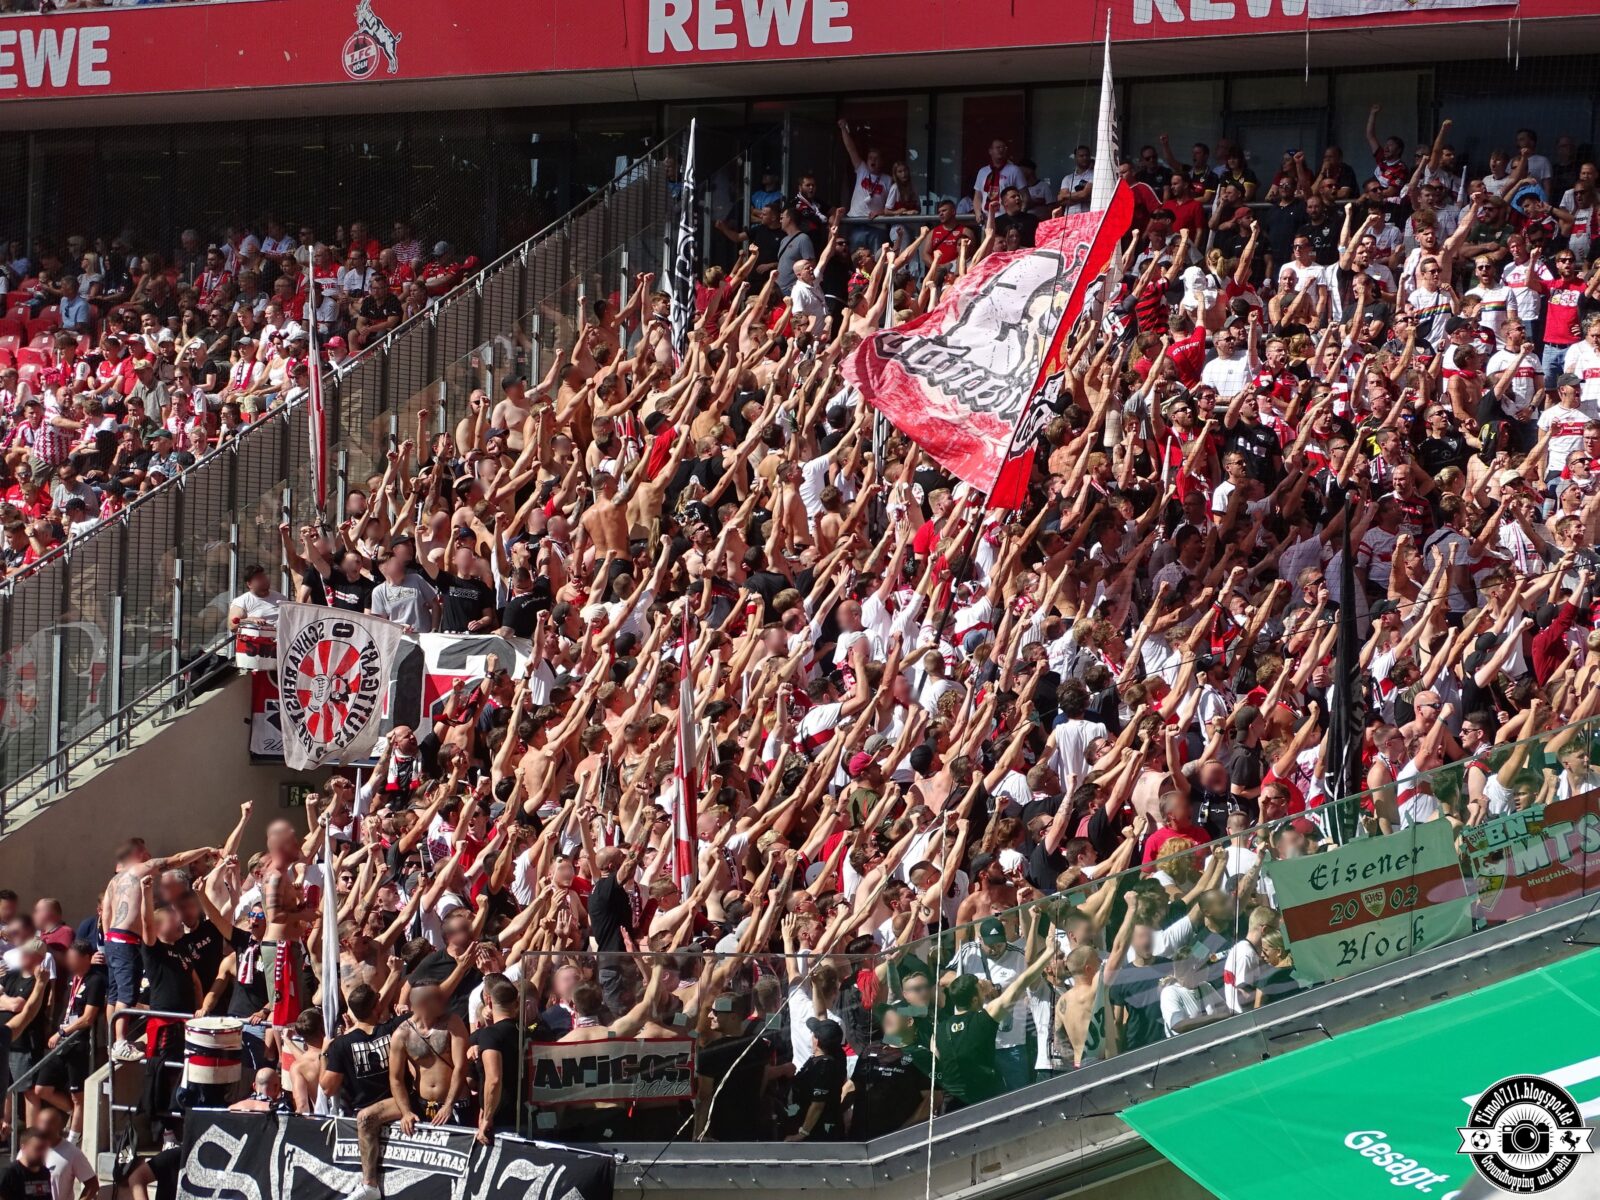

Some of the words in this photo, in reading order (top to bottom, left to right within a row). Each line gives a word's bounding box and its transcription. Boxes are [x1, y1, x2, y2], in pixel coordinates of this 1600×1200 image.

[648, 0, 853, 53] REWE
[1308, 846, 1424, 891] Eisener
[1329, 899, 1359, 926] 20
[1390, 885, 1419, 909] 02
[1336, 914, 1424, 968] Block
[423, 1151, 468, 1172] ULTRAS
[1344, 1130, 1450, 1193] Gesagt.
